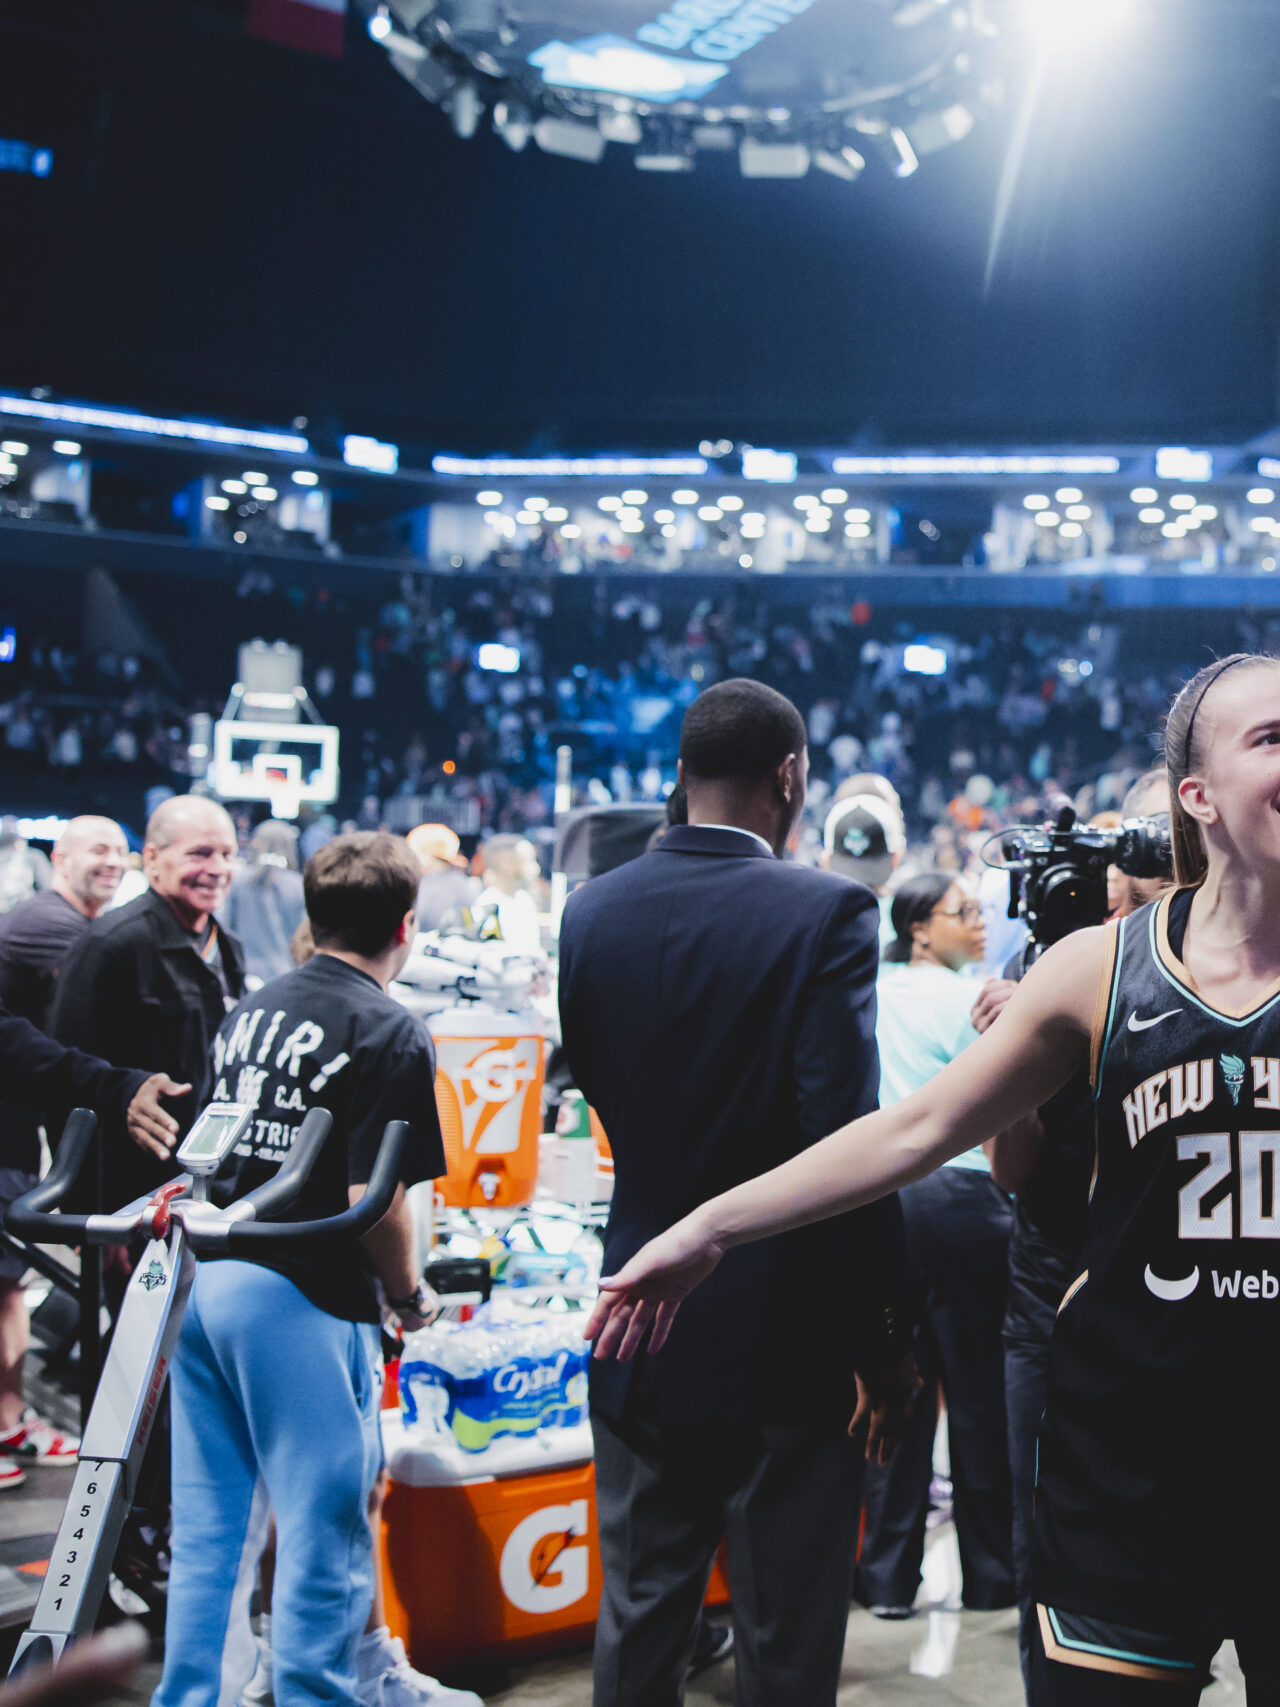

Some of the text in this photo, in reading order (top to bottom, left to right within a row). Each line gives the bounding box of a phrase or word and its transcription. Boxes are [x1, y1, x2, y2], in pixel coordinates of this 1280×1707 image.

[1122, 1058, 1214, 1150] NEW
[87, 1482, 98, 1495] 6
[80, 1505, 91, 1518] 5
[73, 1527, 84, 1540] 4
[66, 1551, 77, 1563] 3
[500, 1499, 589, 1614] G
[59, 1574, 71, 1587] 2
[54, 1598, 63, 1611] 1
